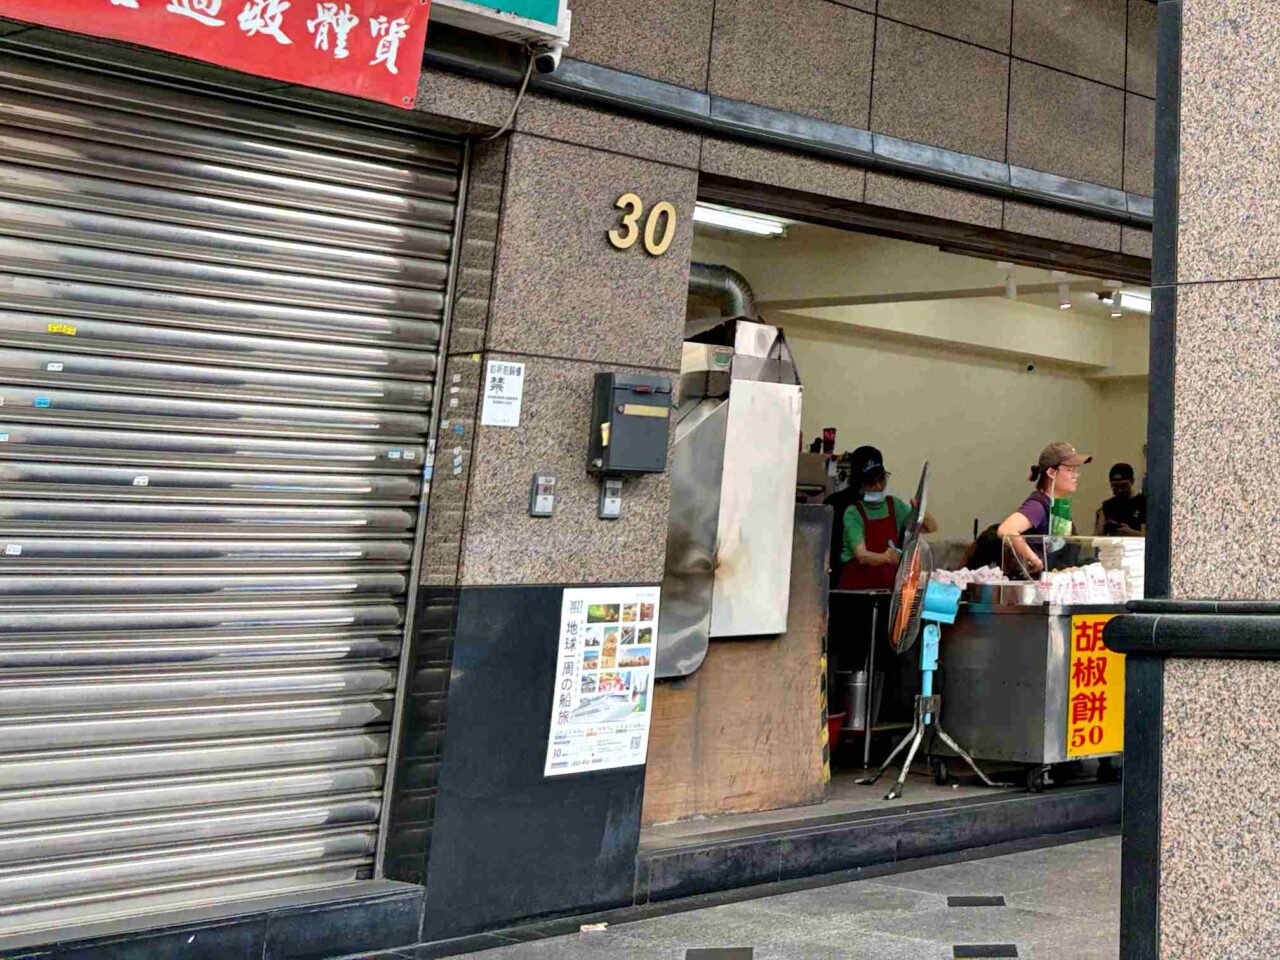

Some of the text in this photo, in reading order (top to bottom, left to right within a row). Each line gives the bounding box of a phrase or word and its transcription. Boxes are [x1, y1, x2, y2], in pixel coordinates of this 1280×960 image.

[608, 192, 677, 256] 30
[557, 620, 578, 725] 地球一周の船旅
[1071, 620, 1108, 725] 胡椒餅
[1071, 725, 1104, 748] 50
